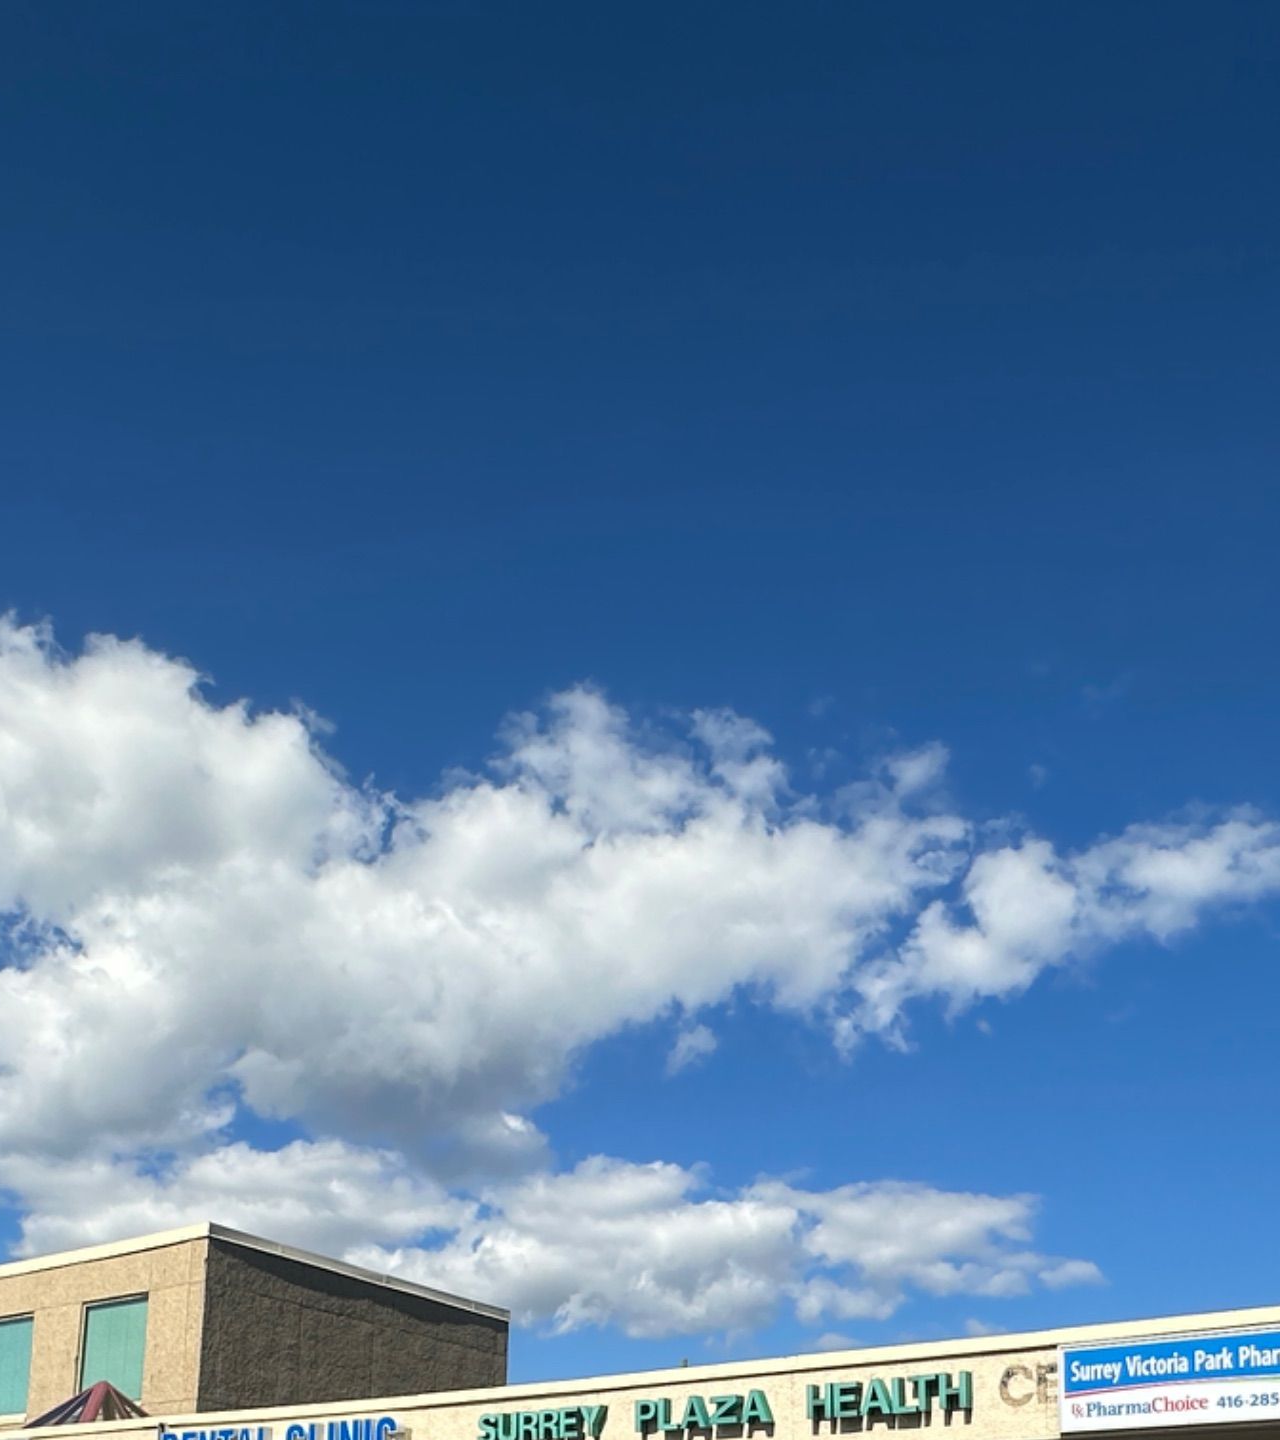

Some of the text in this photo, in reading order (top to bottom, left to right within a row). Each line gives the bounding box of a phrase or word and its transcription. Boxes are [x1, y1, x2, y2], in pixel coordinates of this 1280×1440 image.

[1071, 1360, 1122, 1384] Surrey
[1125, 1350, 1188, 1377] Victoria
[1194, 1347, 1234, 1371] Park
[635, 1390, 773, 1433] PLAZA
[806, 1371, 973, 1420] HEALTH
[1086, 1396, 1209, 1418] PharmaChoice
